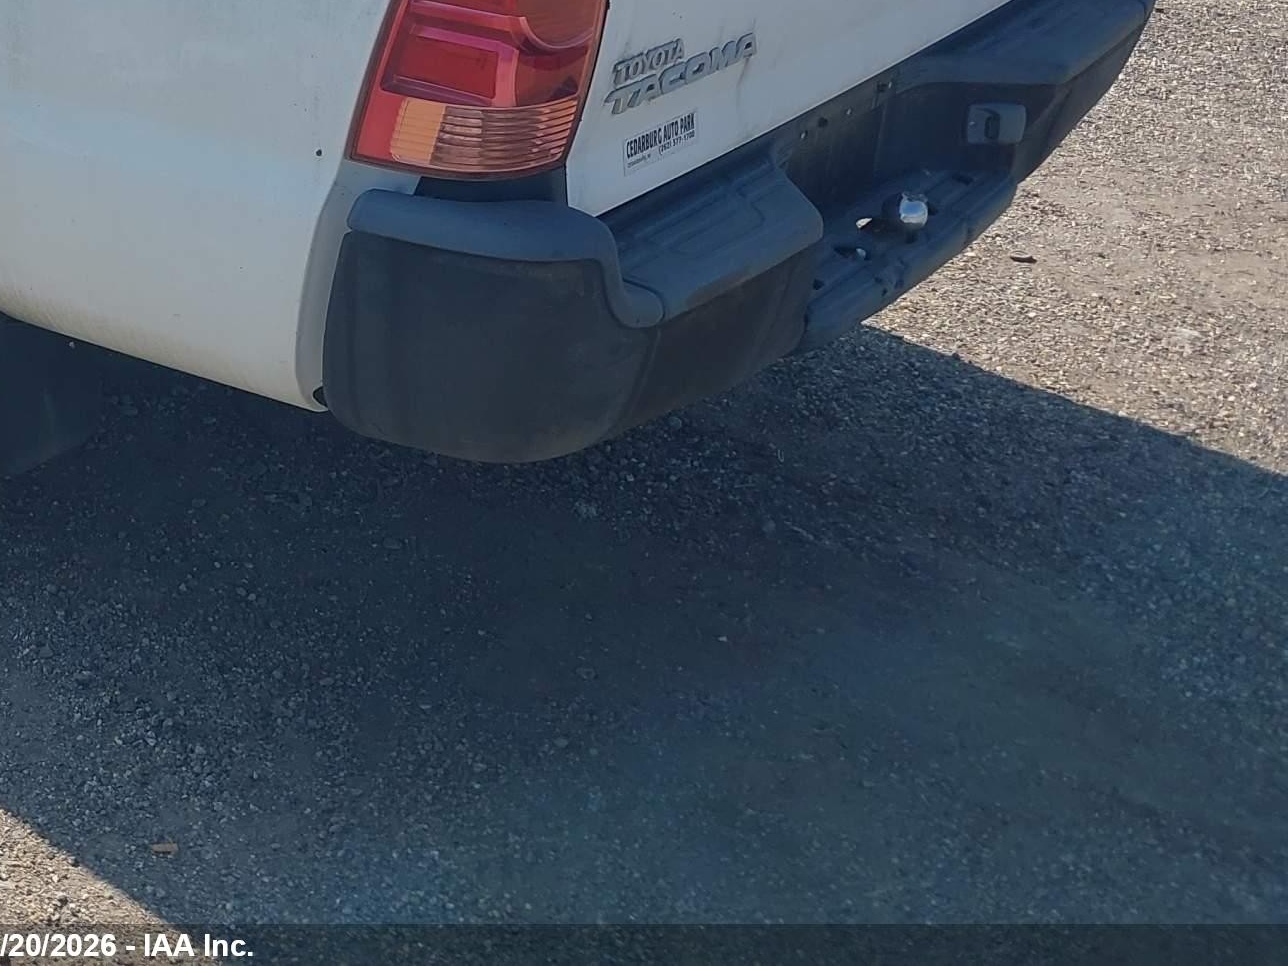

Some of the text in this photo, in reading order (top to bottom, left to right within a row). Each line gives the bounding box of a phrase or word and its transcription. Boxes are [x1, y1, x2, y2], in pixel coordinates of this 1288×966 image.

[603, 32, 757, 114] TACOMA
[613, 38, 685, 84] TOYOTA
[626, 113, 695, 159] CEDARBURG AUTO PARK
